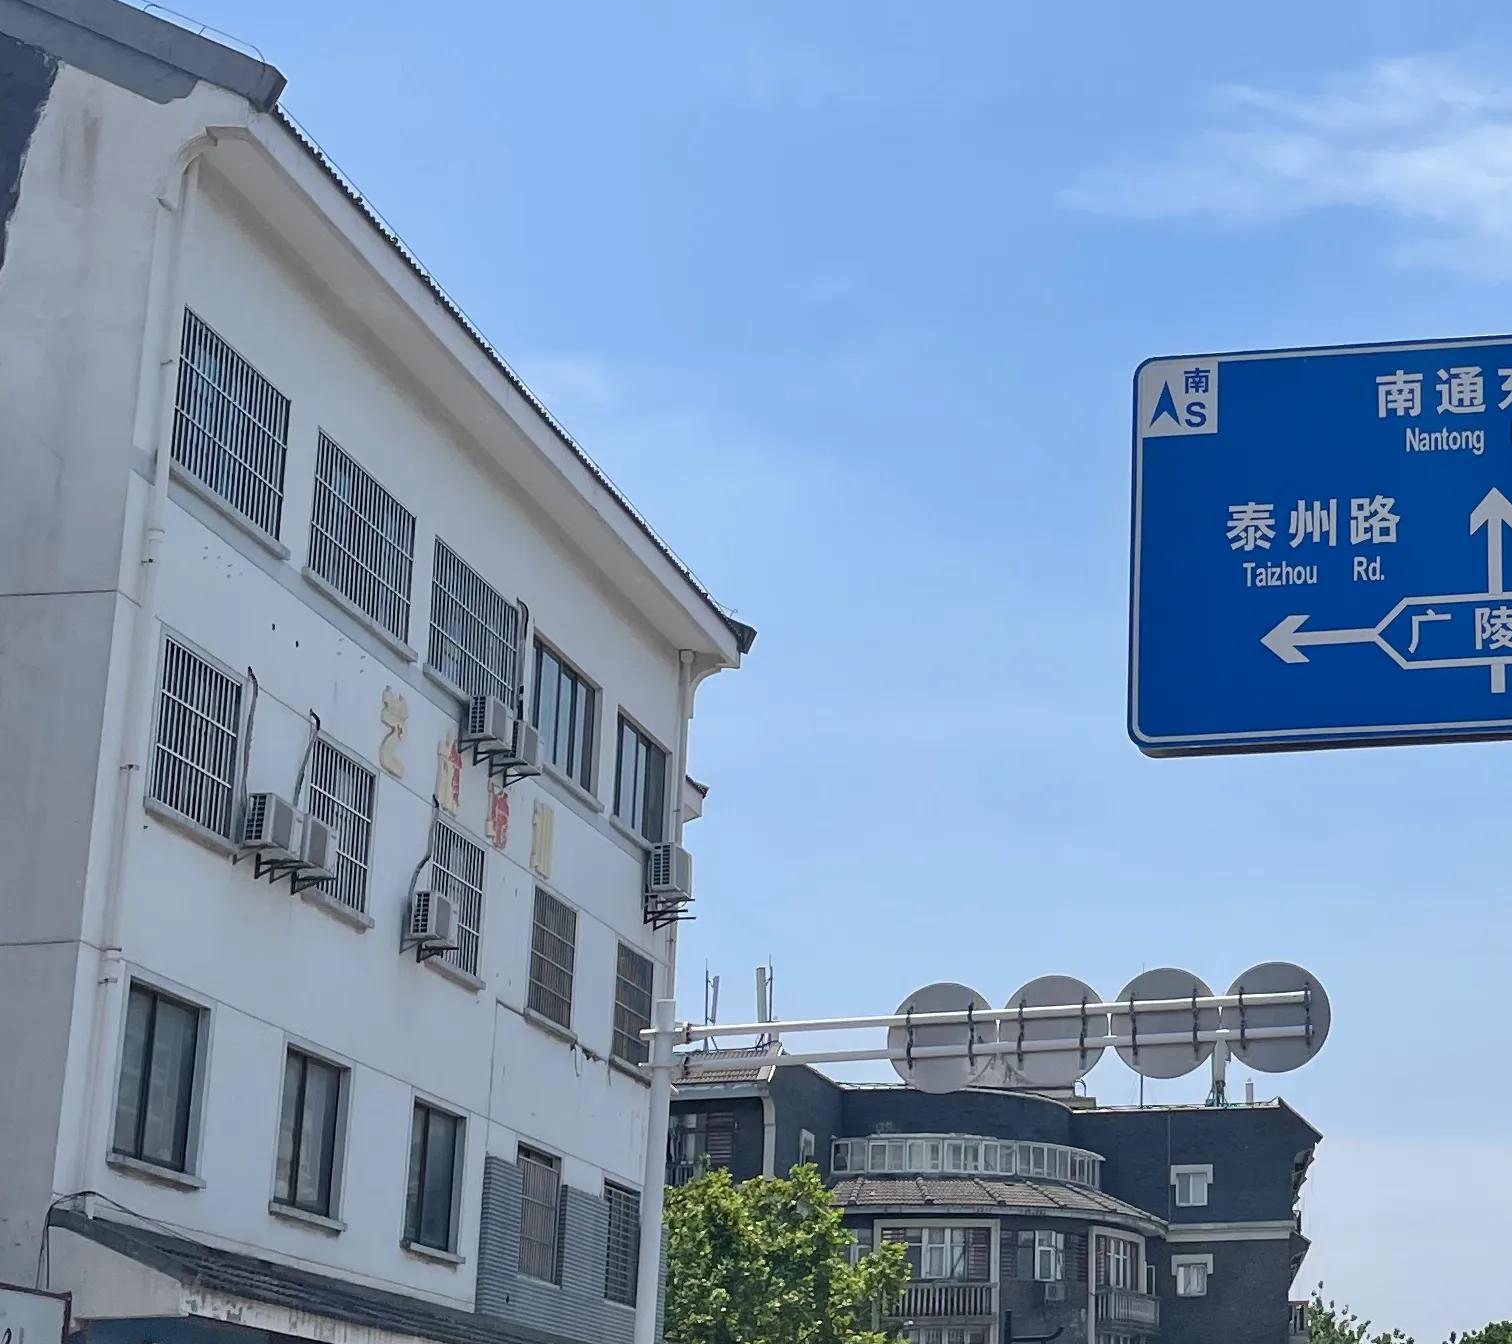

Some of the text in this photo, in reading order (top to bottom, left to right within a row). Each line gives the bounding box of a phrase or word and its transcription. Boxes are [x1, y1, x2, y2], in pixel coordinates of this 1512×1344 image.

[1184, 367, 1210, 394] 南
[1185, 401, 1206, 427] S
[1406, 427, 1484, 455] Nantong
[1226, 494, 1400, 551] 泰州路
[1243, 556, 1385, 587] Taizhou Rd.
